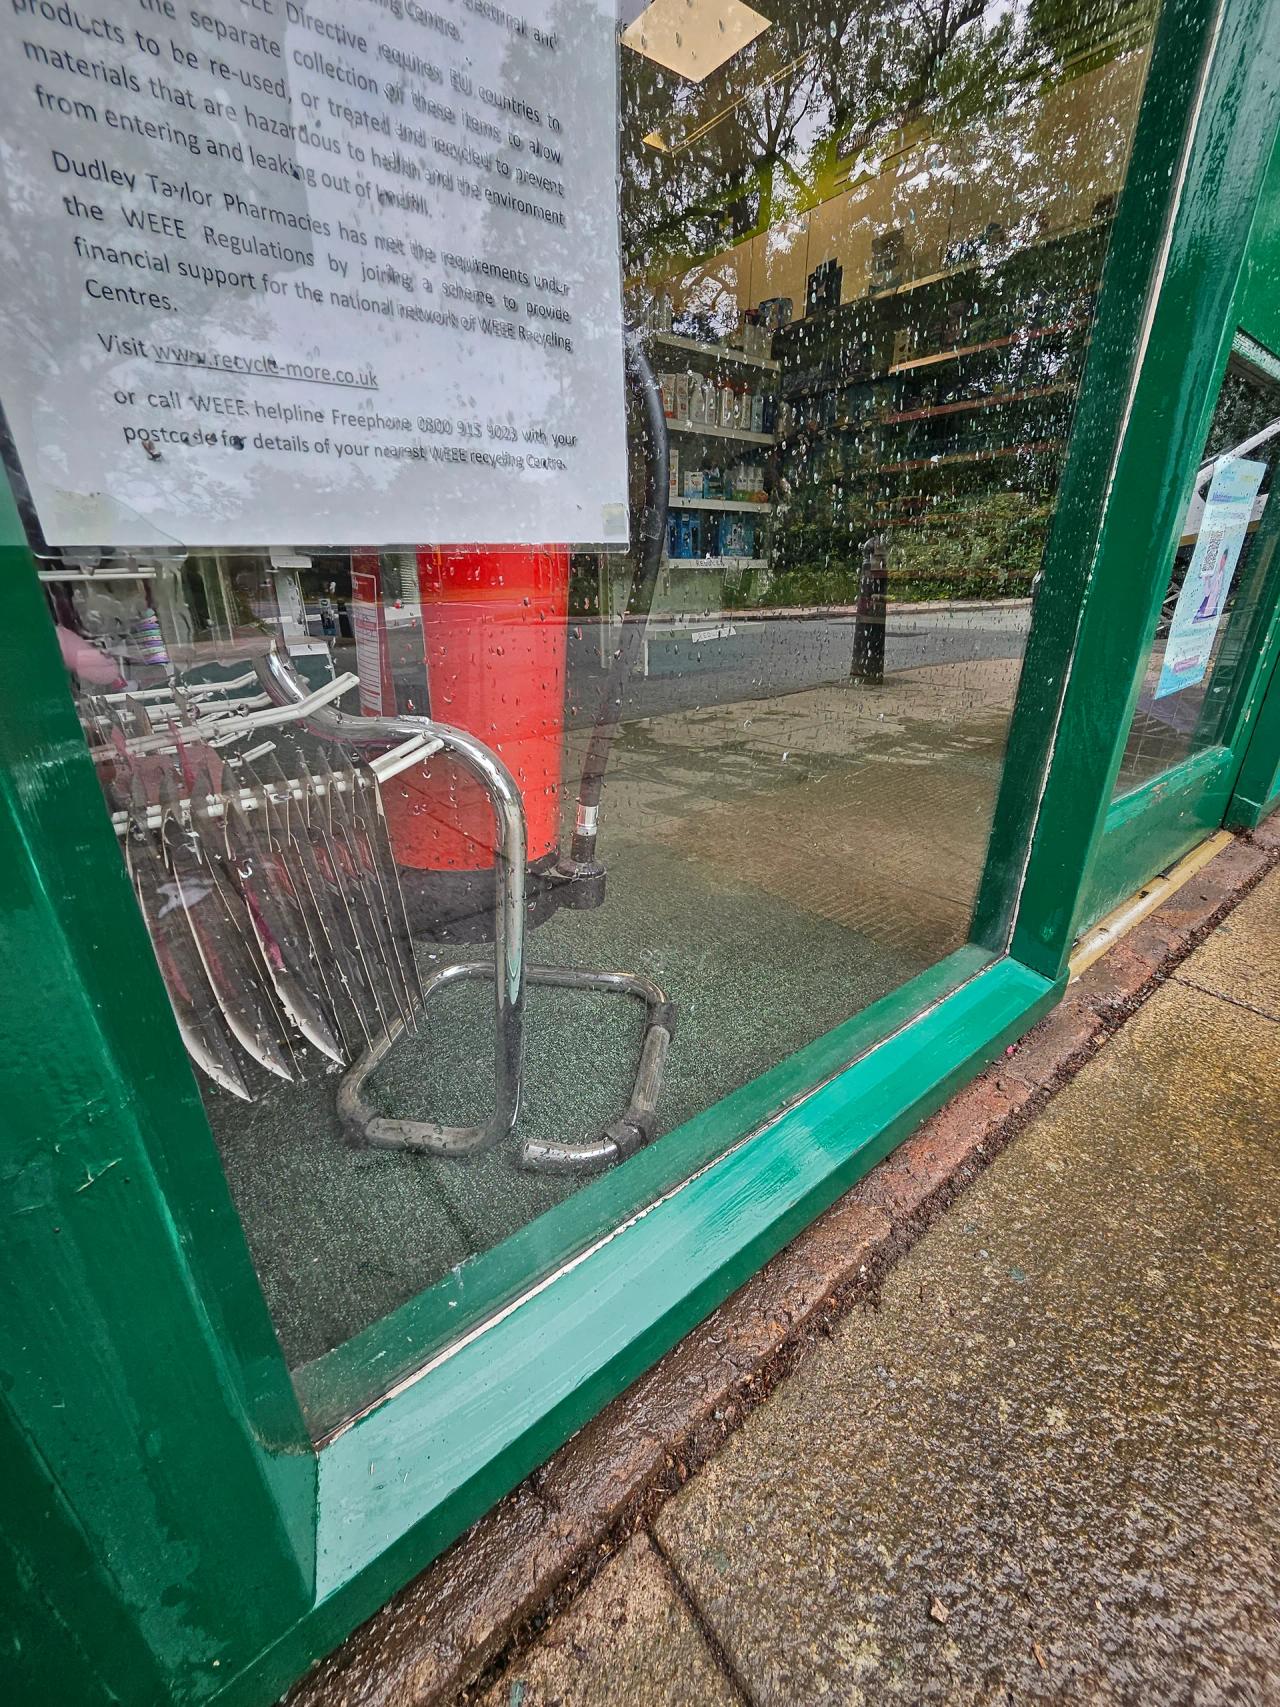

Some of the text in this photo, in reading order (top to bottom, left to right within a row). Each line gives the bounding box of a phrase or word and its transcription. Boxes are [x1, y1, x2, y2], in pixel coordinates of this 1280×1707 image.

[135, 30, 160, 56] to
[171, 40, 199, 70] be
[208, 57, 292, 104] re-used,
[301, 91, 320, 111] or
[327, 99, 390, 136] treated
[395, 119, 427, 148] and
[495, 158, 510, 177] to
[515, 167, 565, 199] prevent
[190, 10, 282, 58] separate
[293, 49, 378, 94] collection
[410, 90, 456, 123] these
[508, 130, 522, 148] to
[286, 2, 367, 53] Directive
[378, 42, 443, 86] requires
[478, 86, 540, 126] countries
[547, 112, 562, 132] to
[22, 40, 141, 94] materials
[150, 77, 197, 110] that
[205, 98, 237, 122] are
[244, 106, 341, 155] hazardous
[347, 139, 365, 163] to
[456, 175, 482, 200] the
[484, 187, 566, 227] environment
[35, 84, 98, 123] from
[105, 108, 201, 155] entering
[207, 138, 244, 163] and
[250, 147, 317, 188] leaking
[320, 170, 351, 195] out
[355, 177, 371, 199] of
[51, 150, 136, 193] Dudley
[145, 173, 213, 208] Taylor
[224, 192, 331, 237] Pharmacies
[338, 221, 368, 247] has
[440, 250, 530, 286] requirements
[62, 196, 572, 324] the WEEE Regulations by joining a scheme to provide
[73, 236, 573, 354] financial support for the national network of WEEE Recycling
[85, 278, 178, 313] Centres.
[97, 333, 379, 389] Visit www.recycle-more.co.uk
[113, 389, 136, 406] or
[147, 392, 181, 410] call
[190, 395, 249, 416] WEEE
[254, 400, 324, 425] helpline
[331, 408, 412, 432] Freephone
[417, 416, 453, 435] 0800
[522, 428, 547, 444] with
[551, 433, 577, 449] your
[124, 424, 217, 448] postcode
[253, 433, 309, 454] details
[314, 438, 330, 454] of
[334, 442, 369, 458] your
[374, 444, 425, 461] nearest
[428, 446, 467, 464] WEEE
[470, 448, 524, 470] recycling
